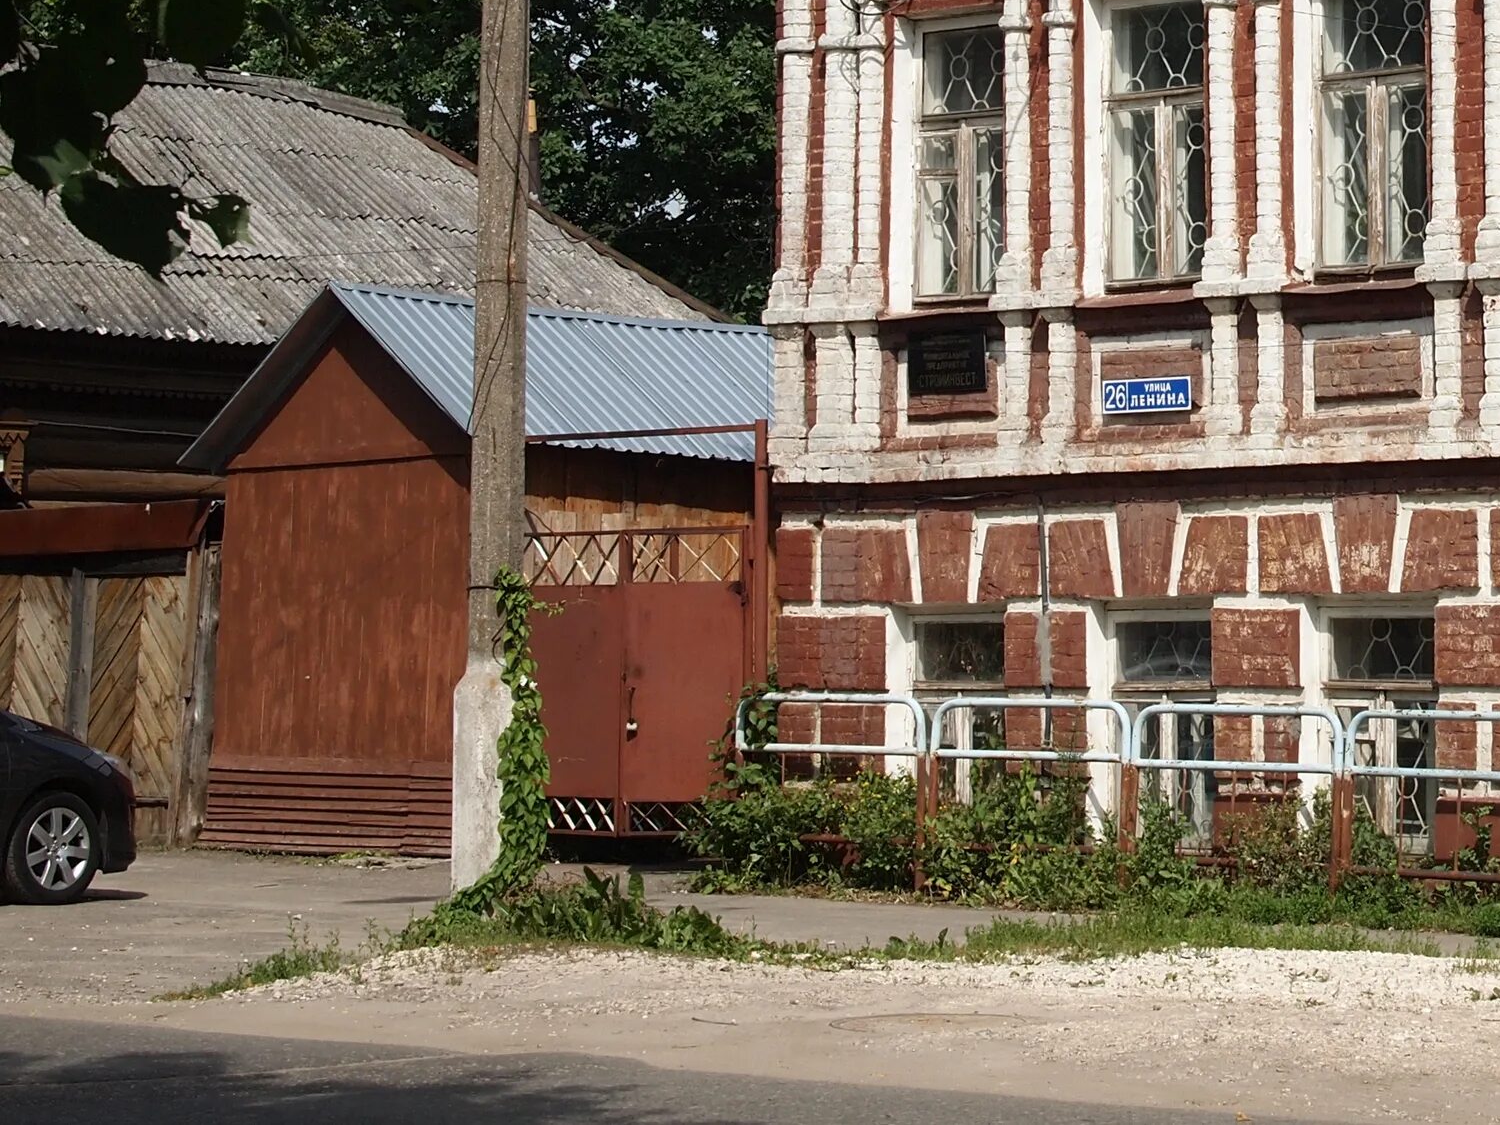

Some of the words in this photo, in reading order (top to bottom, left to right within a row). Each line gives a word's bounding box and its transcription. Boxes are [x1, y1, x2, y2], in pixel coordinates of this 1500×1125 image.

[1144, 382, 1171, 392] УЛИЦА
[1105, 384, 1126, 409] 26
[1130, 392, 1185, 407] ЛЕНИНА
